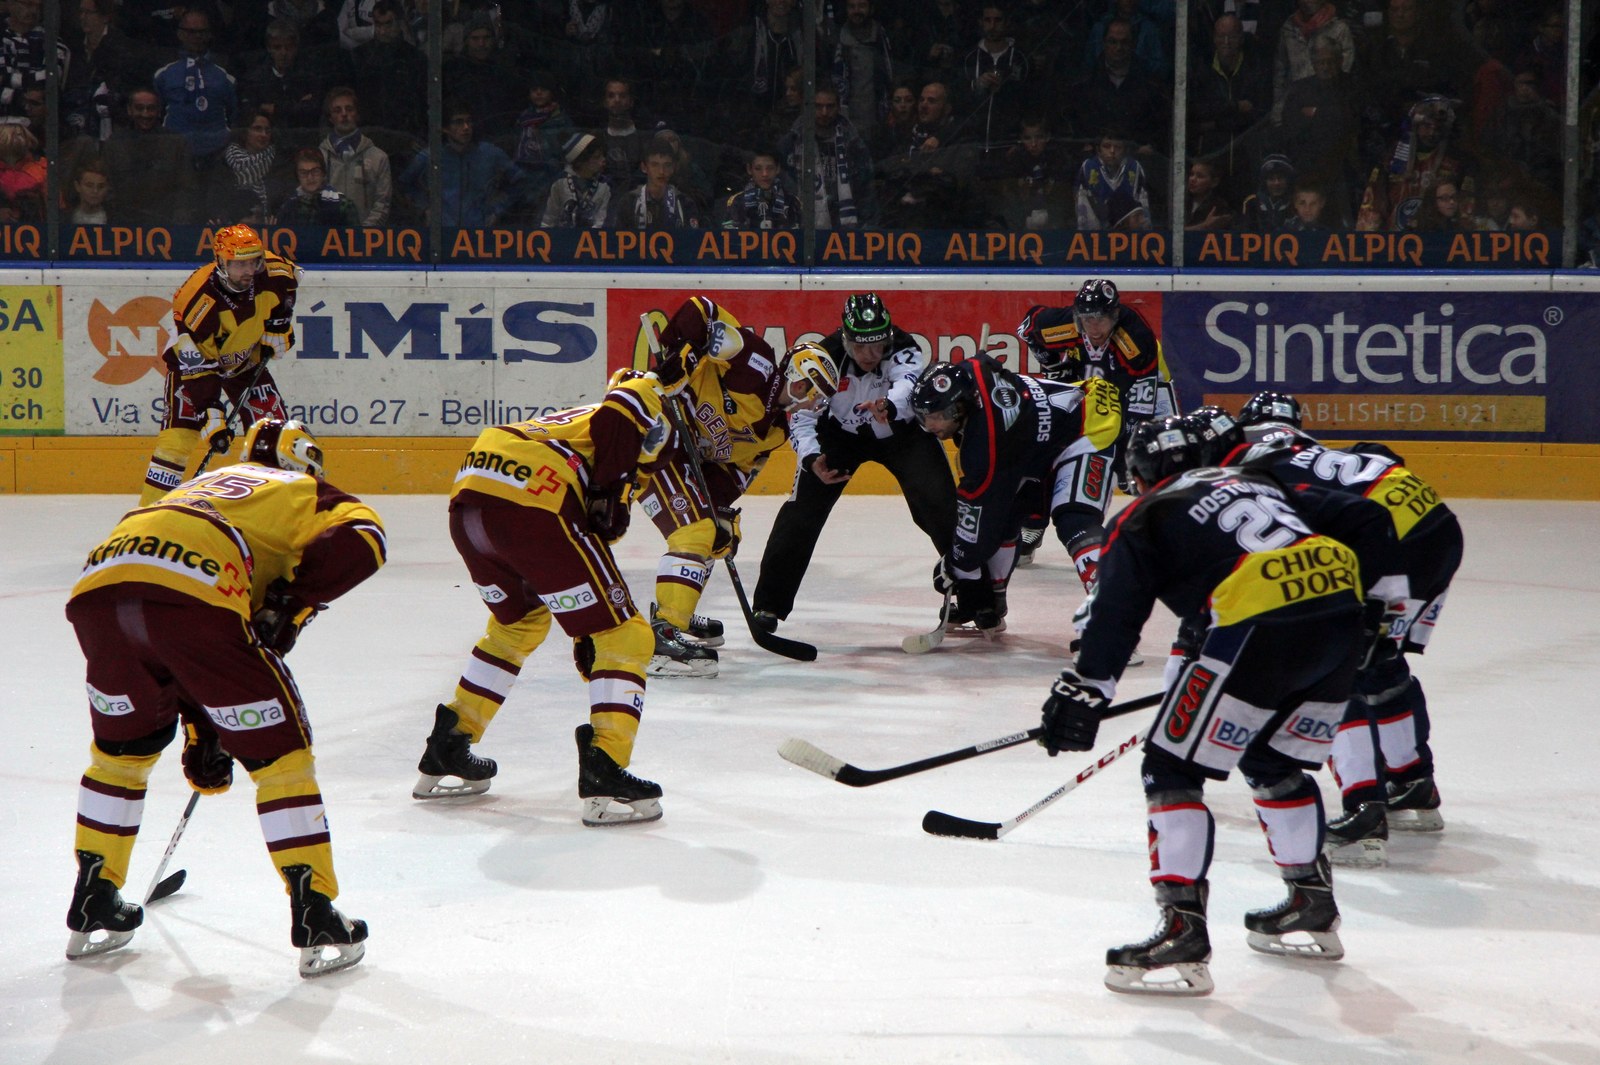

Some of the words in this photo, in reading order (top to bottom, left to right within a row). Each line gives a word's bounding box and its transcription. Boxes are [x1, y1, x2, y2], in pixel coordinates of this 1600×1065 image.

[71, 226, 172, 260] ALPIQ
[195, 226, 298, 260] AIQ
[323, 228, 422, 262] ALPIQ
[452, 229, 551, 263] ALPIQ
[575, 230, 674, 264] ALPIQ
[698, 231, 796, 264] ALPIQ
[823, 231, 921, 264] ALPIQ
[945, 232, 1043, 264] ALPIQ
[1067, 232, 1165, 265] ALPIQ
[1199, 233, 1299, 265] ALPIQ
[1323, 233, 1423, 265] ALPIQ
[1448, 233, 1548, 264] ALPIQ
[1203, 301, 1547, 384] Sintetica
[12, 367, 43, 389] 30
[91, 397, 141, 424] Via
[369, 400, 406, 424] 27
[1300, 402, 1426, 423] ABLISHED
[1440, 404, 1498, 423] 1921
[1076, 734, 1137, 784] CCM
